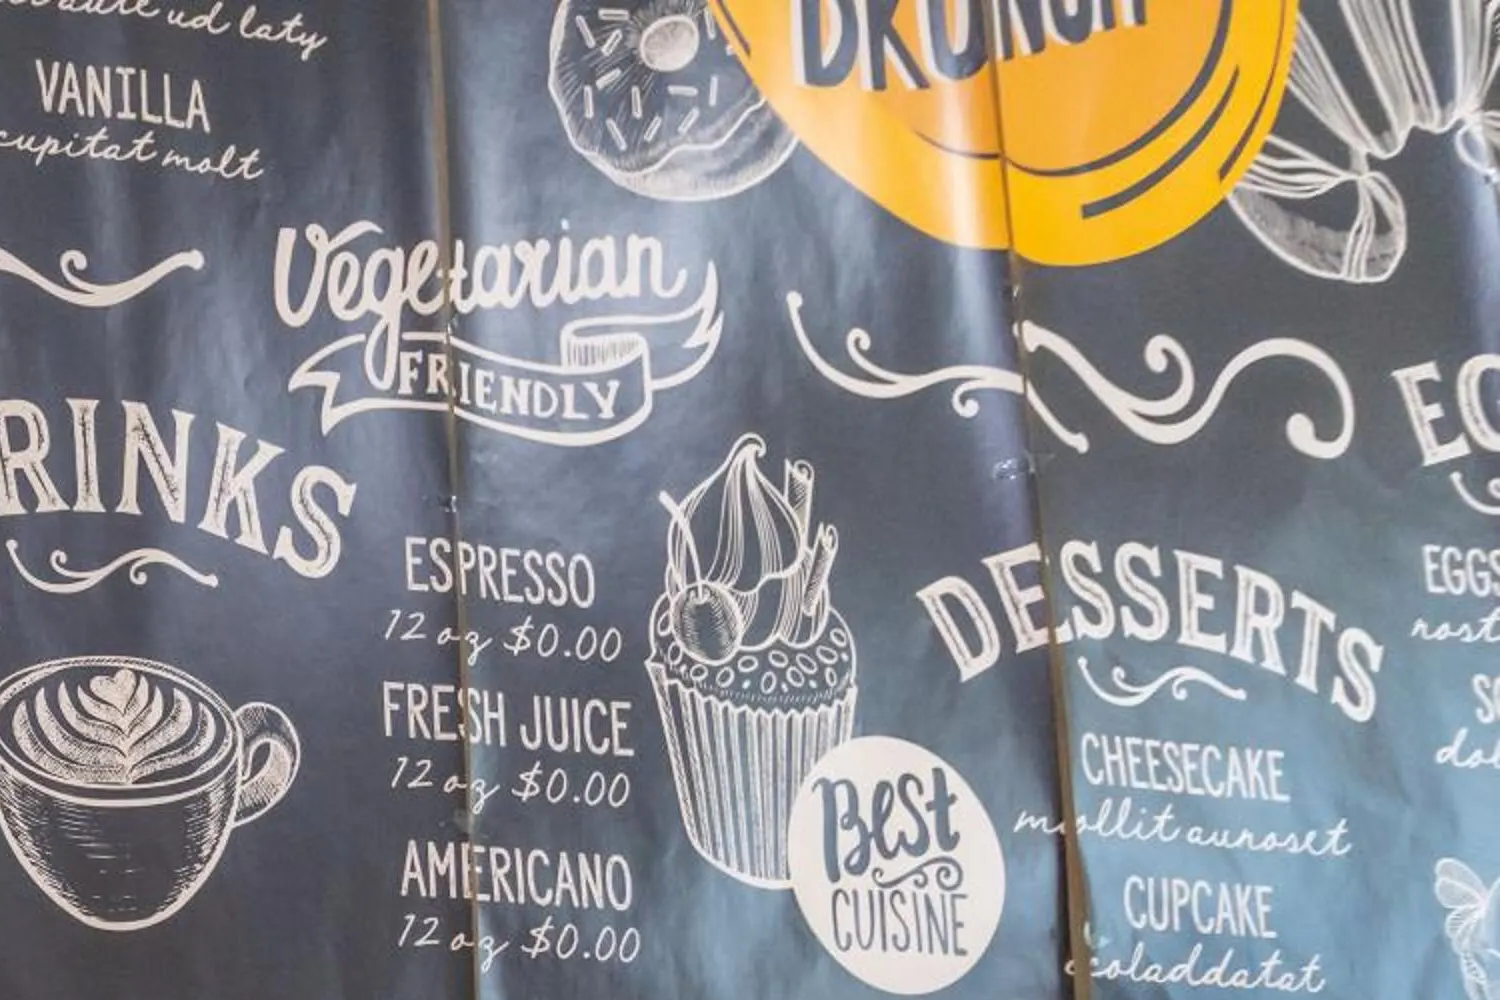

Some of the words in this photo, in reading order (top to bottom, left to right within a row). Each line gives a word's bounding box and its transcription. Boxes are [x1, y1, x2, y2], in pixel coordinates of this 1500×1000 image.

[239, 4, 329, 61] laty
[35, 58, 211, 134] VANILLA
[161, 145, 264, 180] molt
[273, 218, 688, 391] Vegetarian
[397, 350, 620, 421] FRIENDLY
[404, 535, 596, 609] ESPRESSO
[384, 608, 428, 642] 12
[503, 615, 622, 663] $0.00
[915, 539, 1385, 723] DESSERTS
[382, 680, 508, 748] FRESH
[519, 695, 635, 757] JUICE
[390, 756, 433, 789] 12
[511, 761, 631, 808] $0.00
[1080, 732, 1291, 803] CHEESECAKE
[811, 766, 961, 885] Best
[400, 838, 634, 912] AMERICANO
[1122, 874, 1278, 940] CUPCAKE
[398, 913, 441, 947] 12
[520, 916, 641, 963] $0.00
[831, 887, 969, 957] CUISINE
